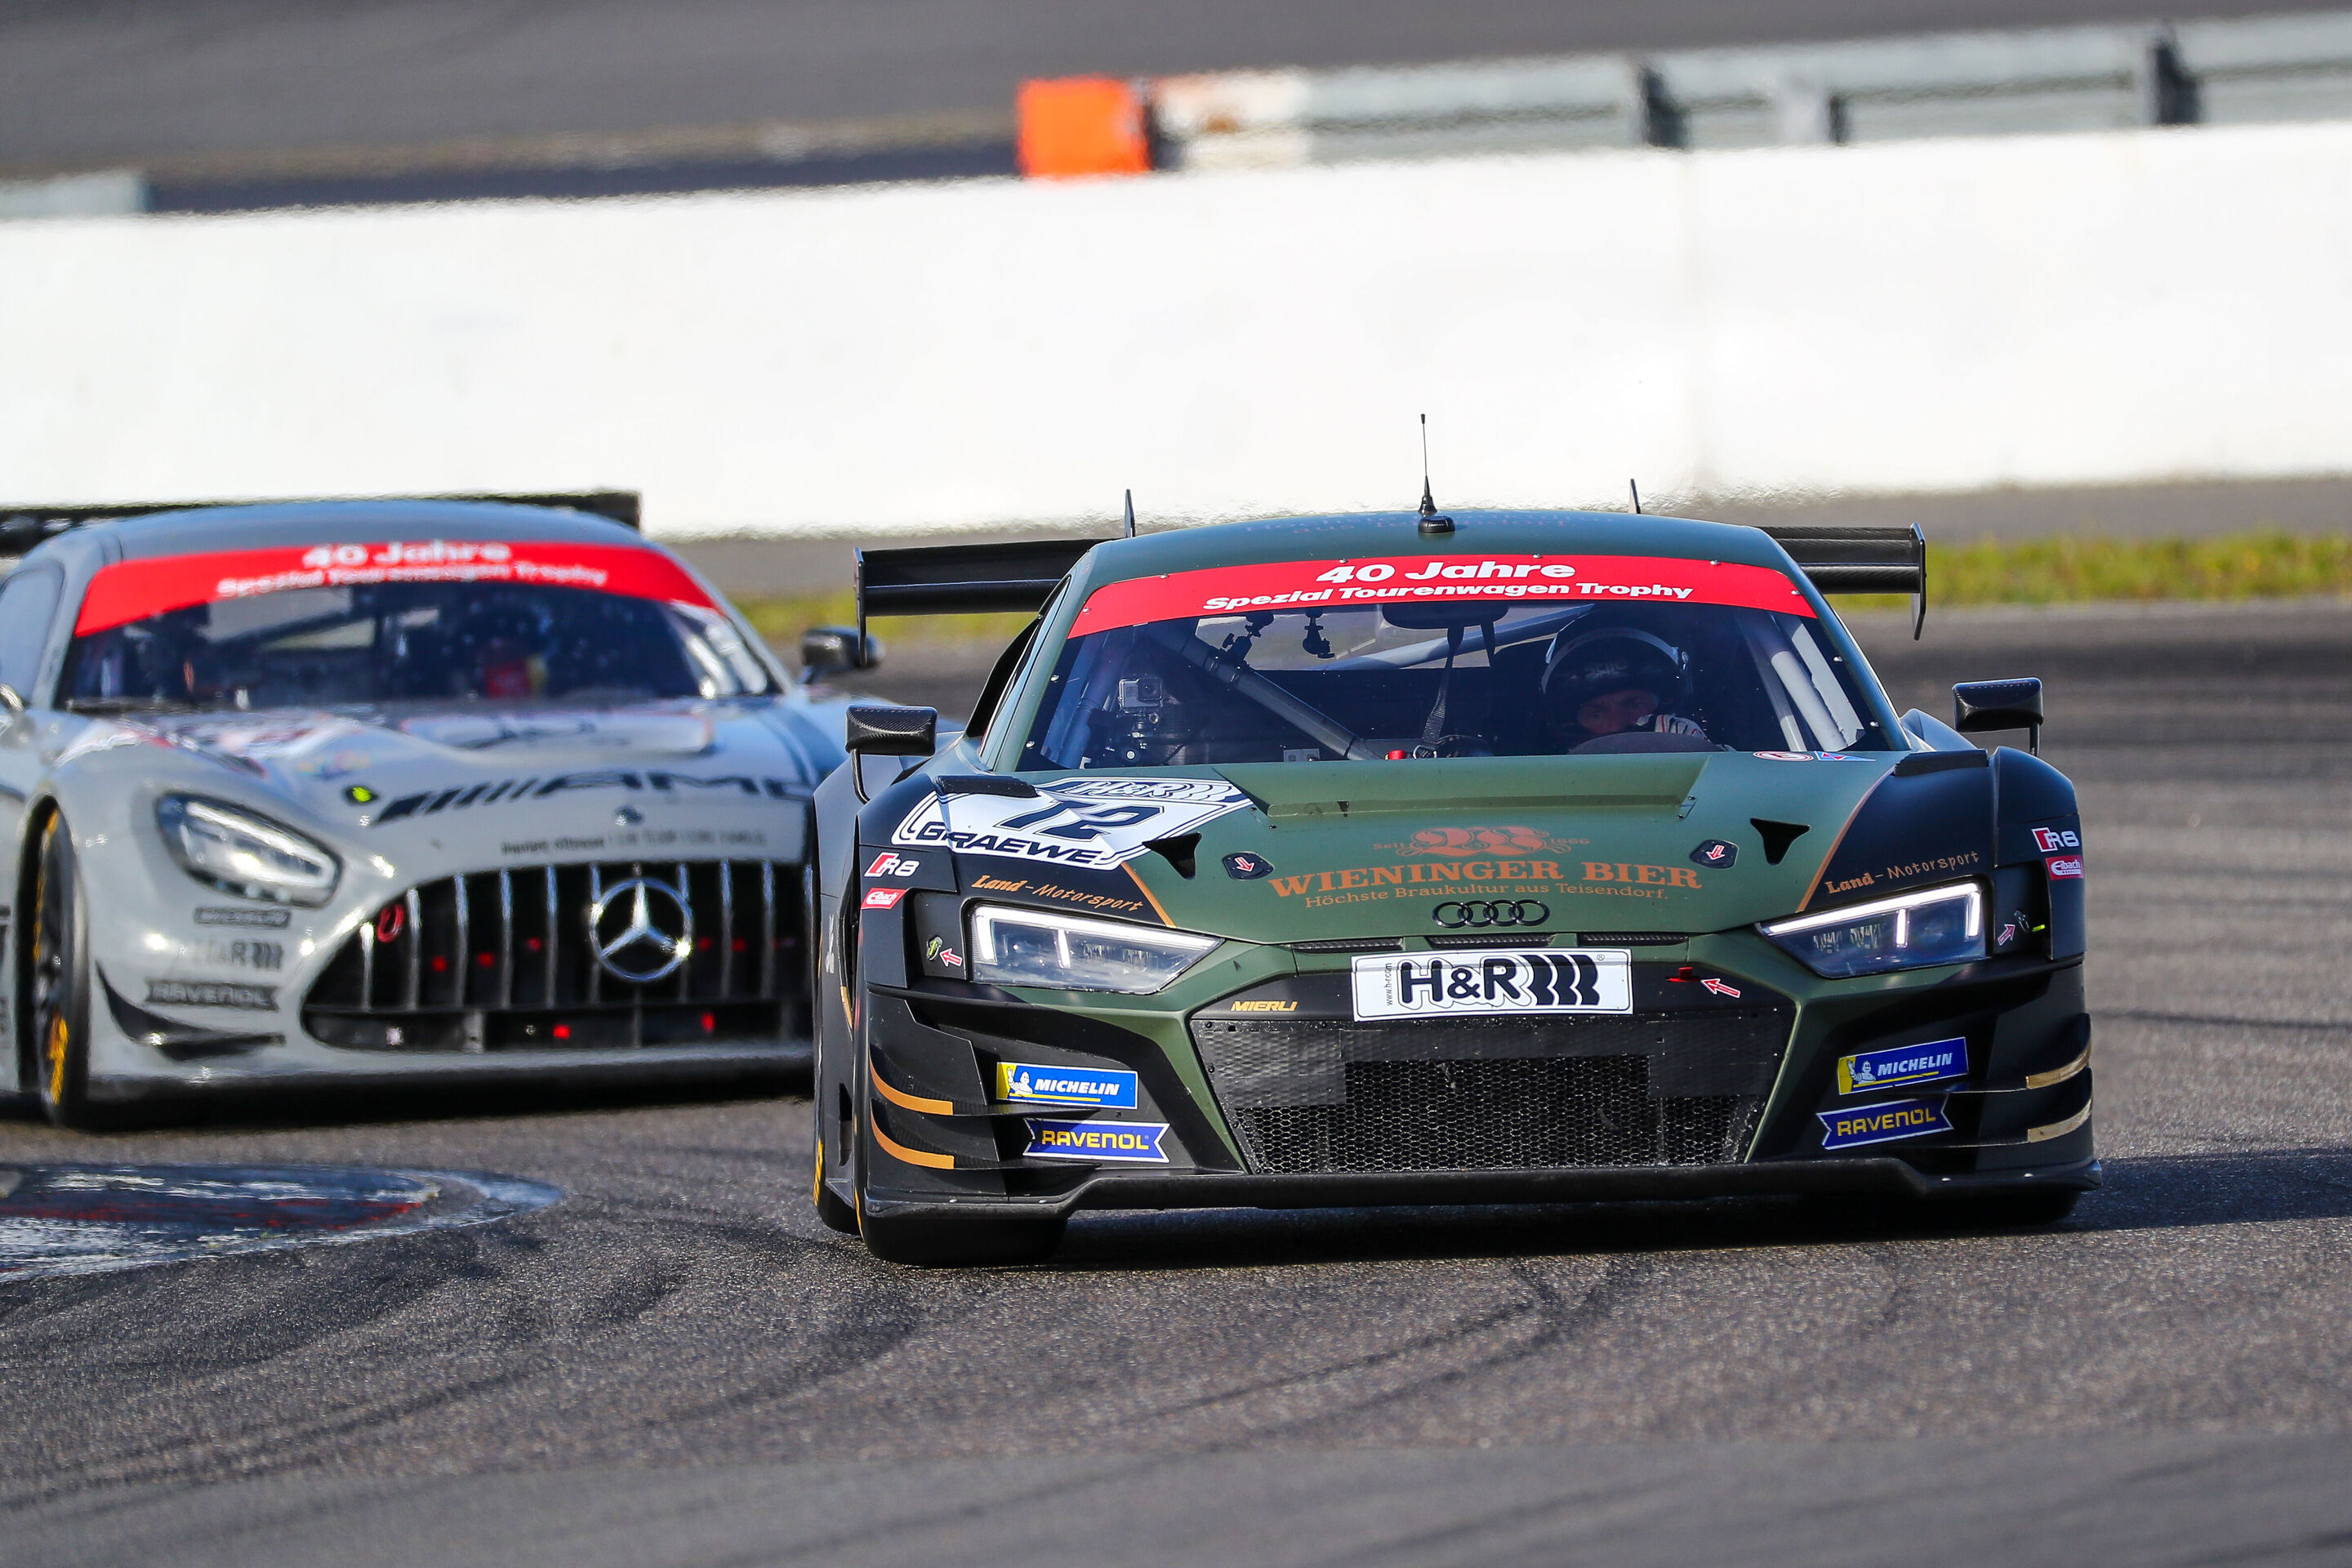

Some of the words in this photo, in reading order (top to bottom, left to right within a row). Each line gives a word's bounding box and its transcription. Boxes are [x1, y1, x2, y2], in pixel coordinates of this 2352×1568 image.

[303, 542, 368, 568] 40
[373, 539, 511, 564] Jahre
[1316, 564, 1396, 583] 40
[1404, 561, 1575, 581] Jahre
[1202, 590, 1331, 610] Spezial
[1338, 582, 1573, 599] Tourenwagen
[1576, 582, 1694, 600] Trophy
[1066, 781, 1186, 798] H&R
[916, 822, 1103, 863] GRAEWE
[2038, 829, 2079, 849] R8
[871, 855, 920, 877] R8
[1267, 861, 1565, 898] WIENINGER
[1581, 862, 1702, 889] BIER
[1305, 890, 1388, 908] Höchste
[1394, 883, 1509, 898] Braukultur
[1515, 884, 1549, 893] aus
[1400, 958, 1522, 1004] H&R
[1878, 1052, 1953, 1077] MICHELIN
[1034, 1078, 1120, 1096] MICHELIN
[1837, 1107, 1936, 1137] RAVENOL
[1041, 1129, 1150, 1151] RAVENOL
